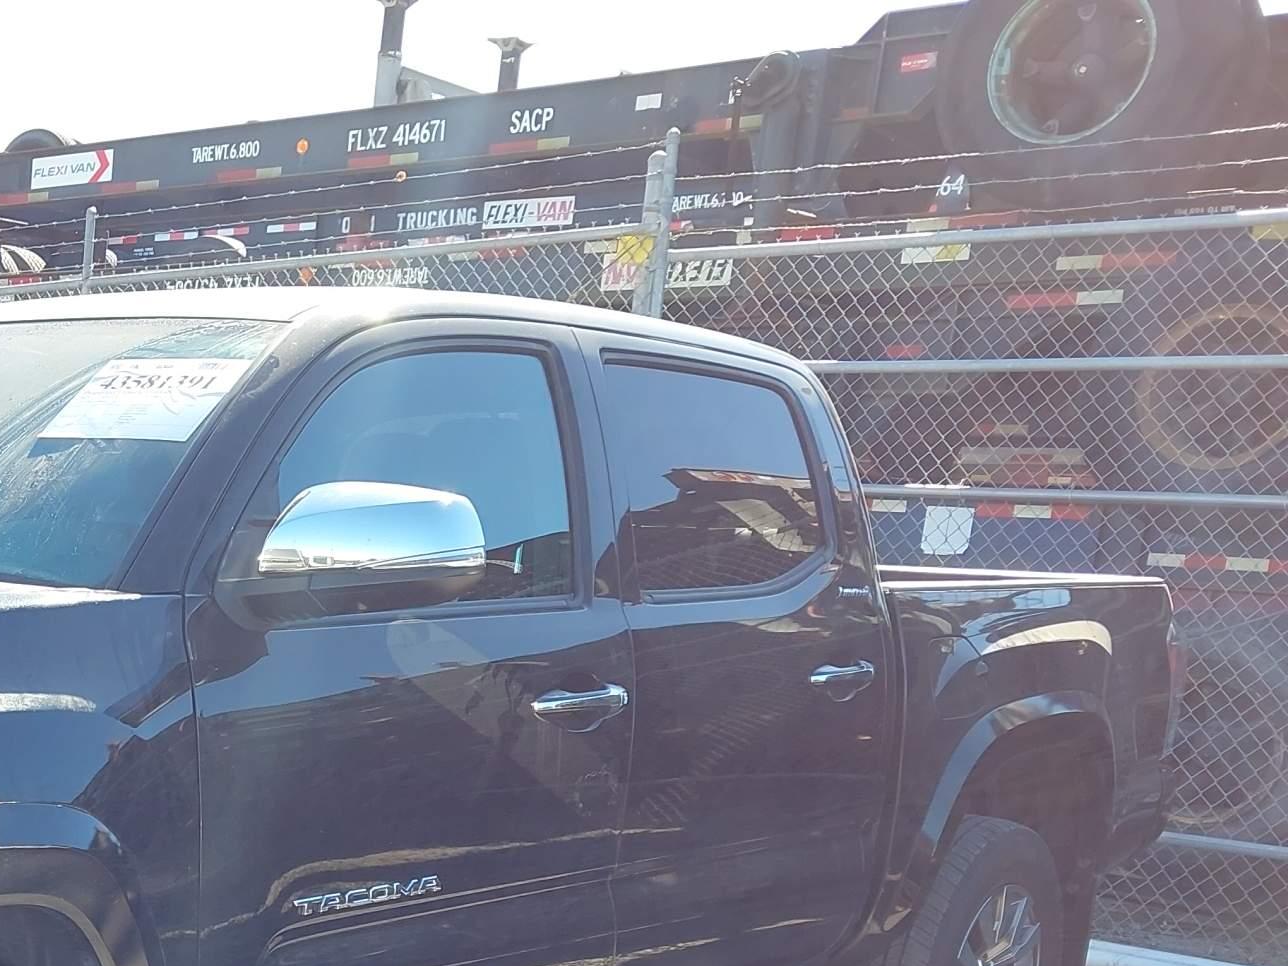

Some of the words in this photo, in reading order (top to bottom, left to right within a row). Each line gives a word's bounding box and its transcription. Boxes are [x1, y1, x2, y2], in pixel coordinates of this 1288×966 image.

[509, 107, 555, 134] SACP
[347, 125, 388, 152] FLXZ
[391, 119, 447, 148] 414671
[32, 164, 68, 179] FLEXI
[70, 161, 96, 175] VAN
[397, 207, 478, 232] TRUCKING
[99, 375, 218, 390] 43581391
[292, 874, 442, 916] TACOMA
